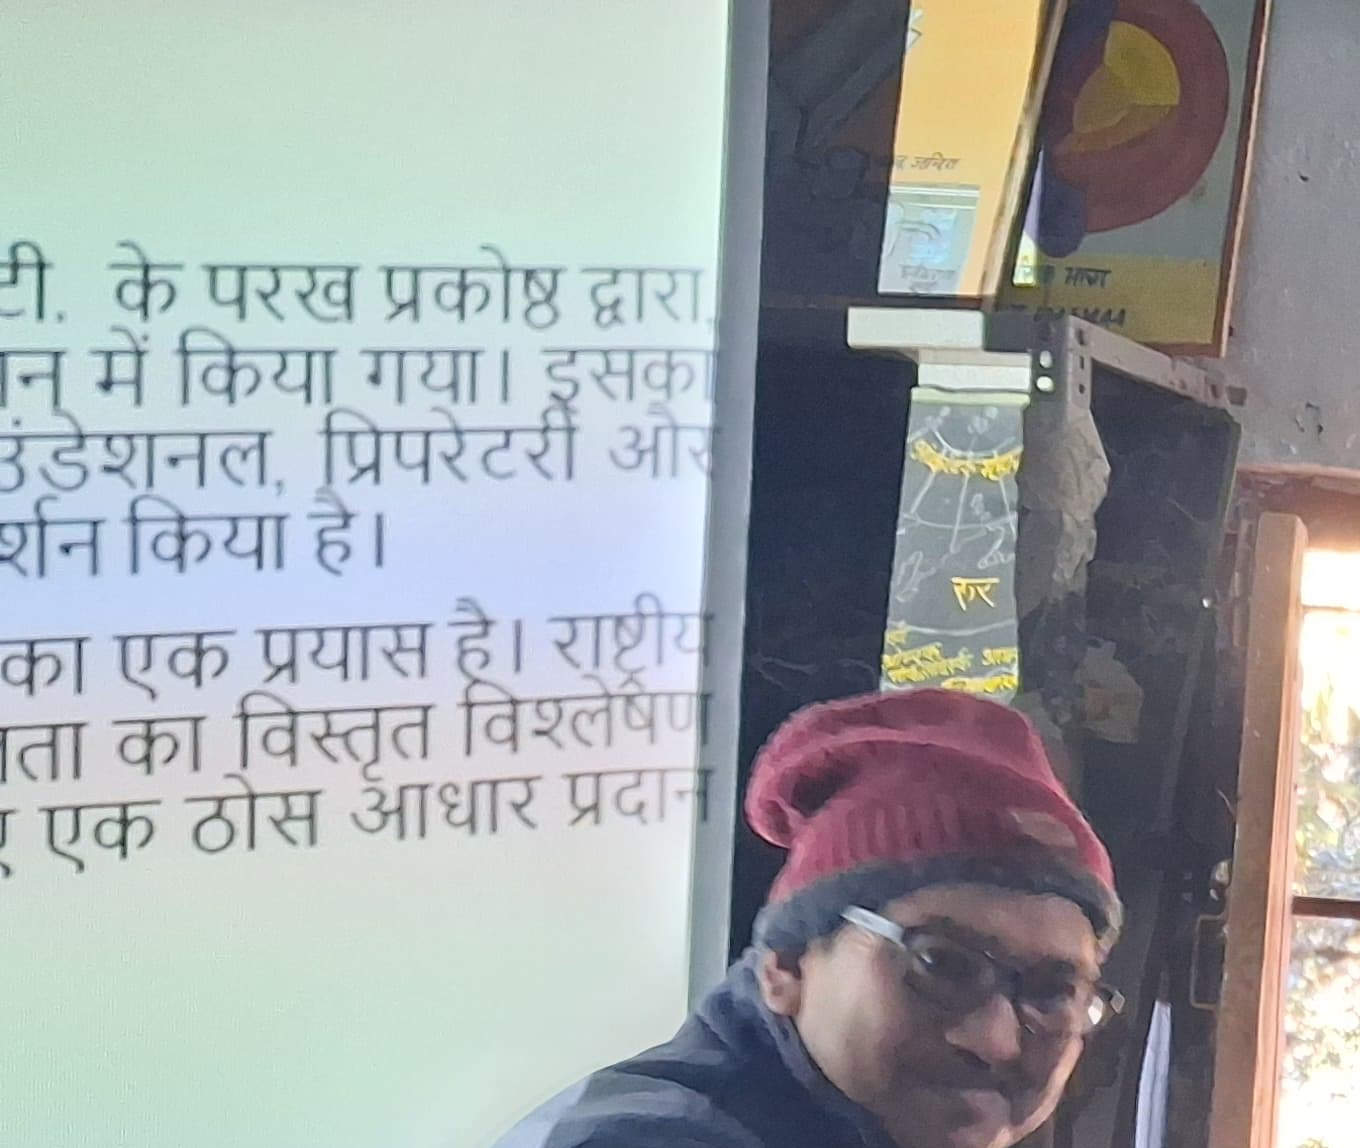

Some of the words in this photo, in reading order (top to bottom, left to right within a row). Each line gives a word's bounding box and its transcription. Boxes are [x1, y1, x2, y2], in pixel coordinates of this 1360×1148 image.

[110, 241, 184, 322] के
[201, 264, 358, 324] परख
[379, 244, 565, 330] प्रकोष्ठ
[91, 325, 151, 408] में
[176, 326, 336, 406] किया
[318, 406, 578, 488] प्रिपरेटरी
[122, 494, 290, 577] किया
[0, 635, 91, 698] का
[113, 628, 237, 702] एक
[254, 622, 435, 688] प्रयास
[112, 714, 206, 777] का
[232, 689, 436, 785] विस्तृत
[456, 674, 714, 758] विश्लेषण
[38, 799, 162, 877] एक
[184, 774, 324, 856] ठोस
[351, 775, 542, 842] आधार
[562, 766, 716, 830] प्रदान
